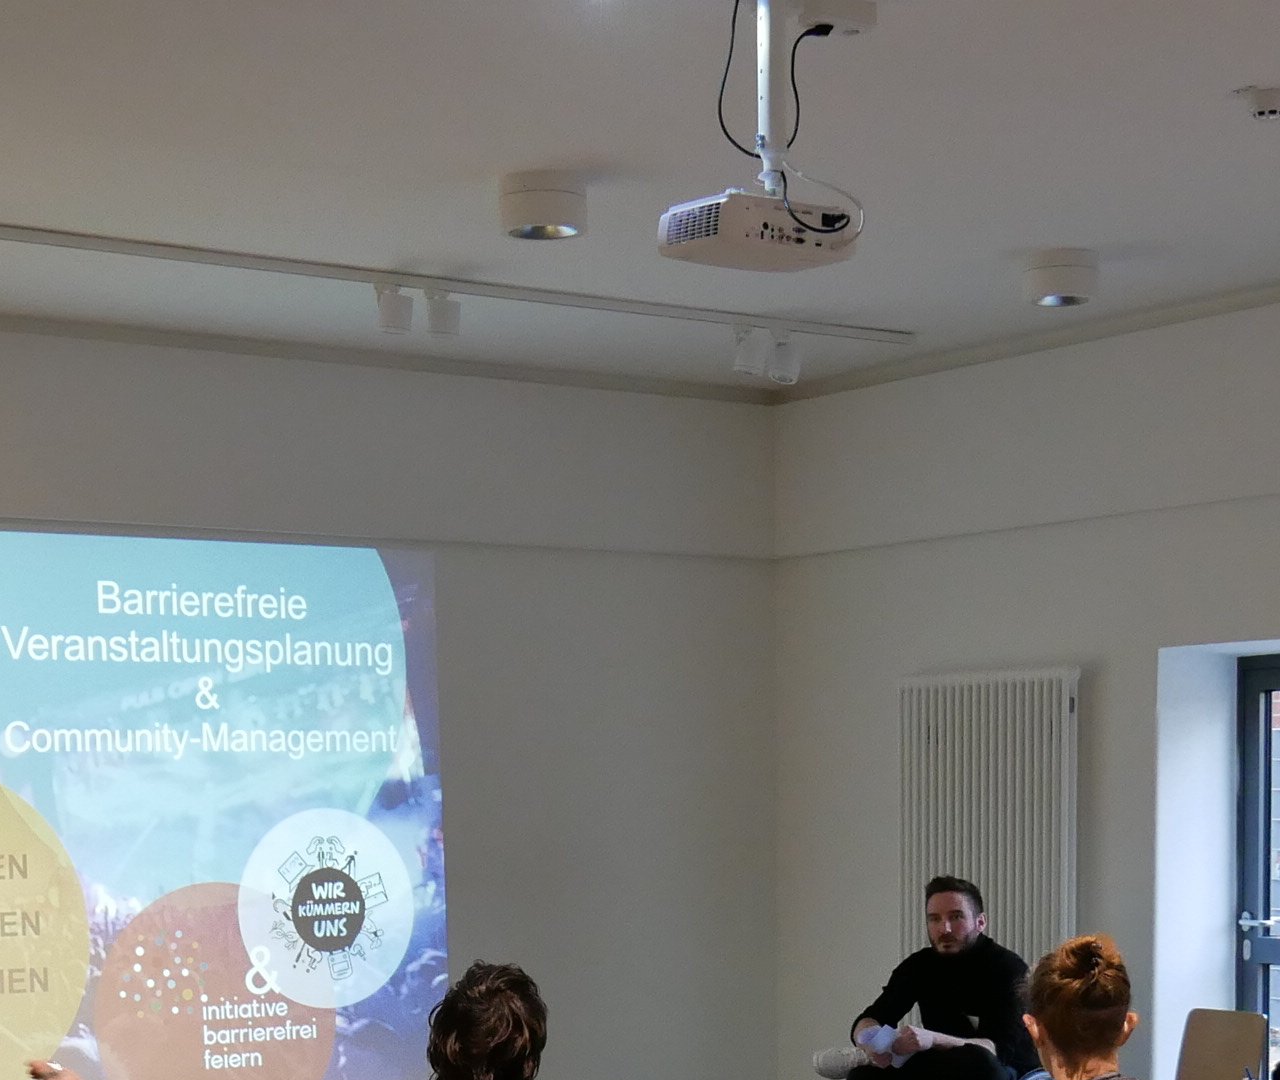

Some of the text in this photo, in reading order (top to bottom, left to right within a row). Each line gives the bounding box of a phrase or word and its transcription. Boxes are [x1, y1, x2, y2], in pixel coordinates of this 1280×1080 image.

[96, 580, 308, 620] Barrierefreie
[1, 625, 393, 675] Veranstaltungsplanung
[195, 676, 221, 710] &
[4, 720, 398, 760] Community-Management
[311, 881, 347, 900] WIR
[298, 900, 360, 918] KÜMMERN
[313, 918, 348, 938] UNS
[245, 945, 282, 995] &
[202, 995, 289, 1020] initiative
[203, 1018, 317, 1045] barrierefrei
[204, 1047, 263, 1069] feiern
